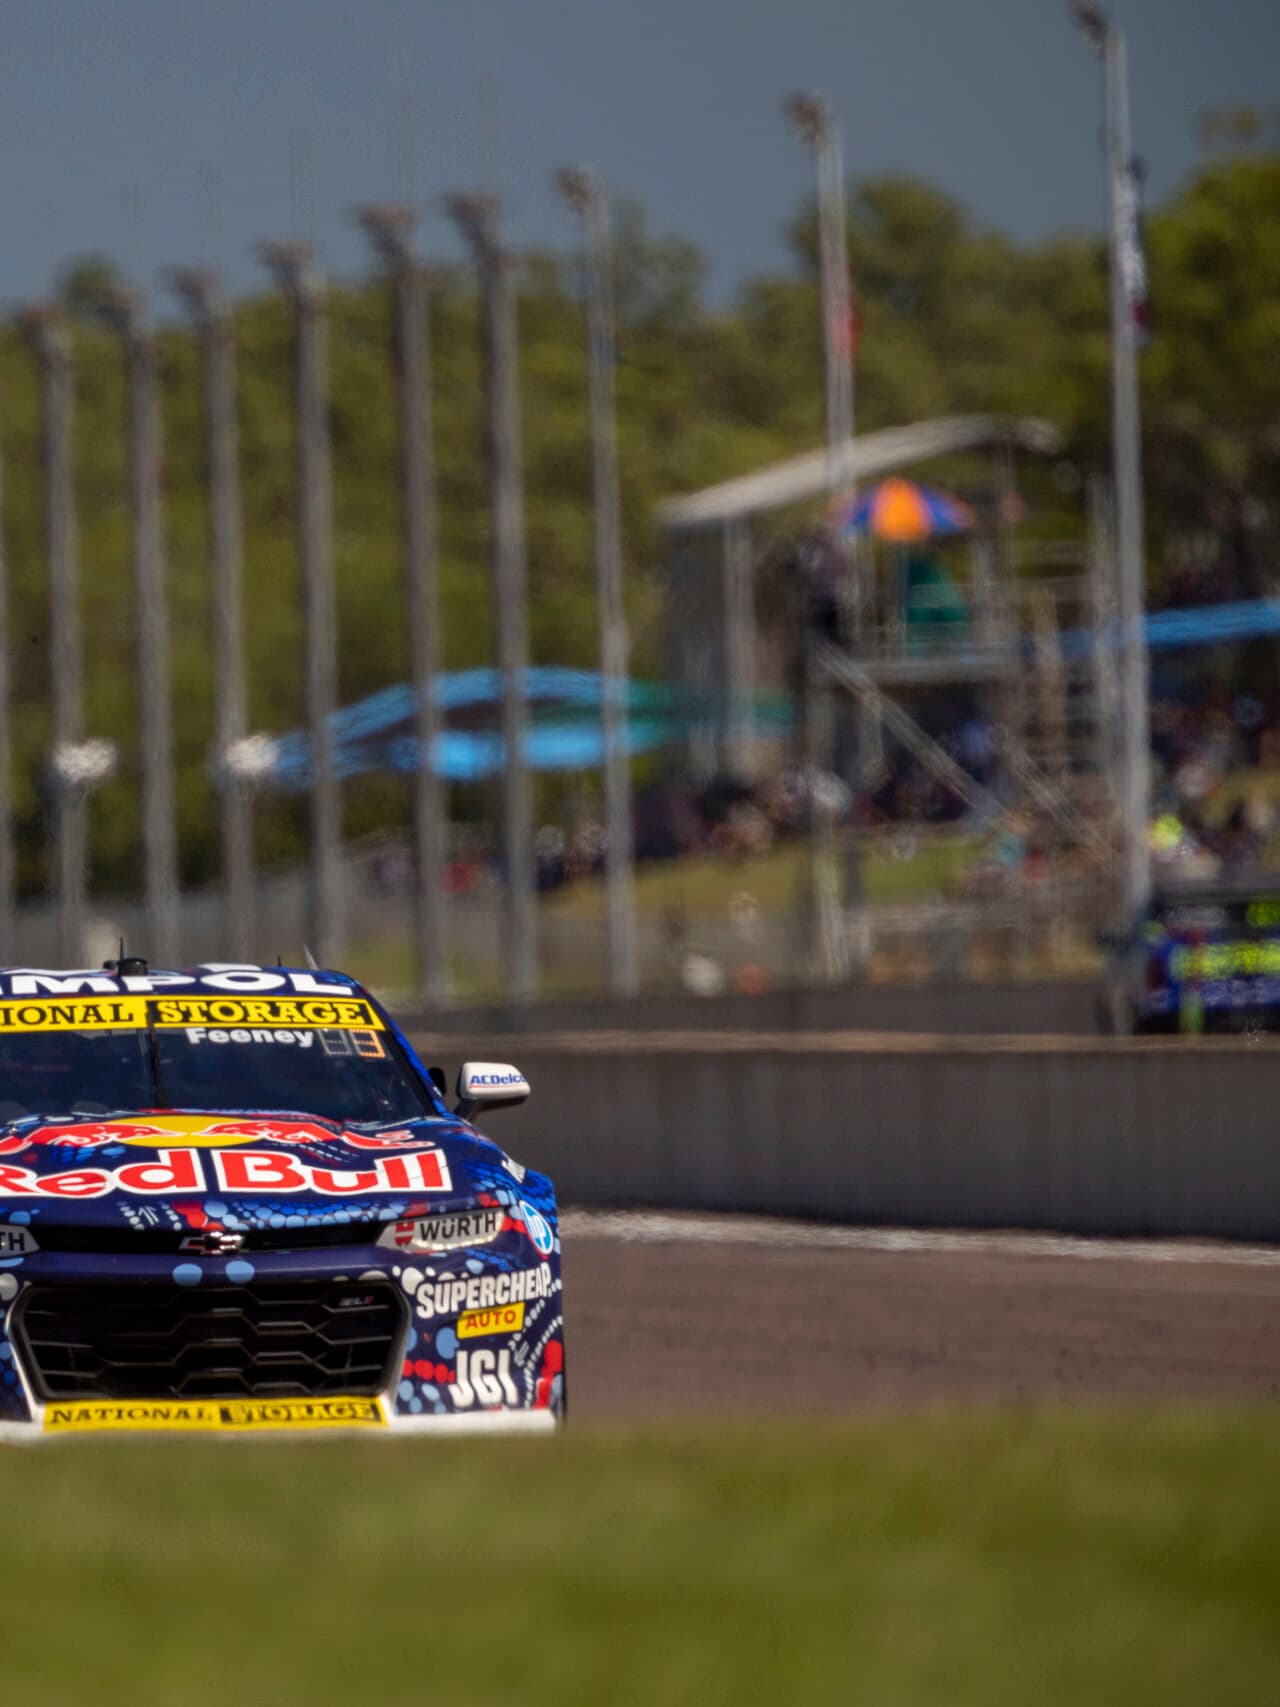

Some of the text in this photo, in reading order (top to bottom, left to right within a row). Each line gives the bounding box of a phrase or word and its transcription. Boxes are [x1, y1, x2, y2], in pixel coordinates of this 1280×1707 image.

[157, 1001, 365, 1025] STORAGE
[185, 1027, 313, 1048] Feeney
[211, 1149, 453, 1193] Bull
[416, 1262, 551, 1319] SUPERCHEAP
[464, 1309, 516, 1329] AUTO
[52, 1402, 375, 1425] NATIONAL STORAGE
